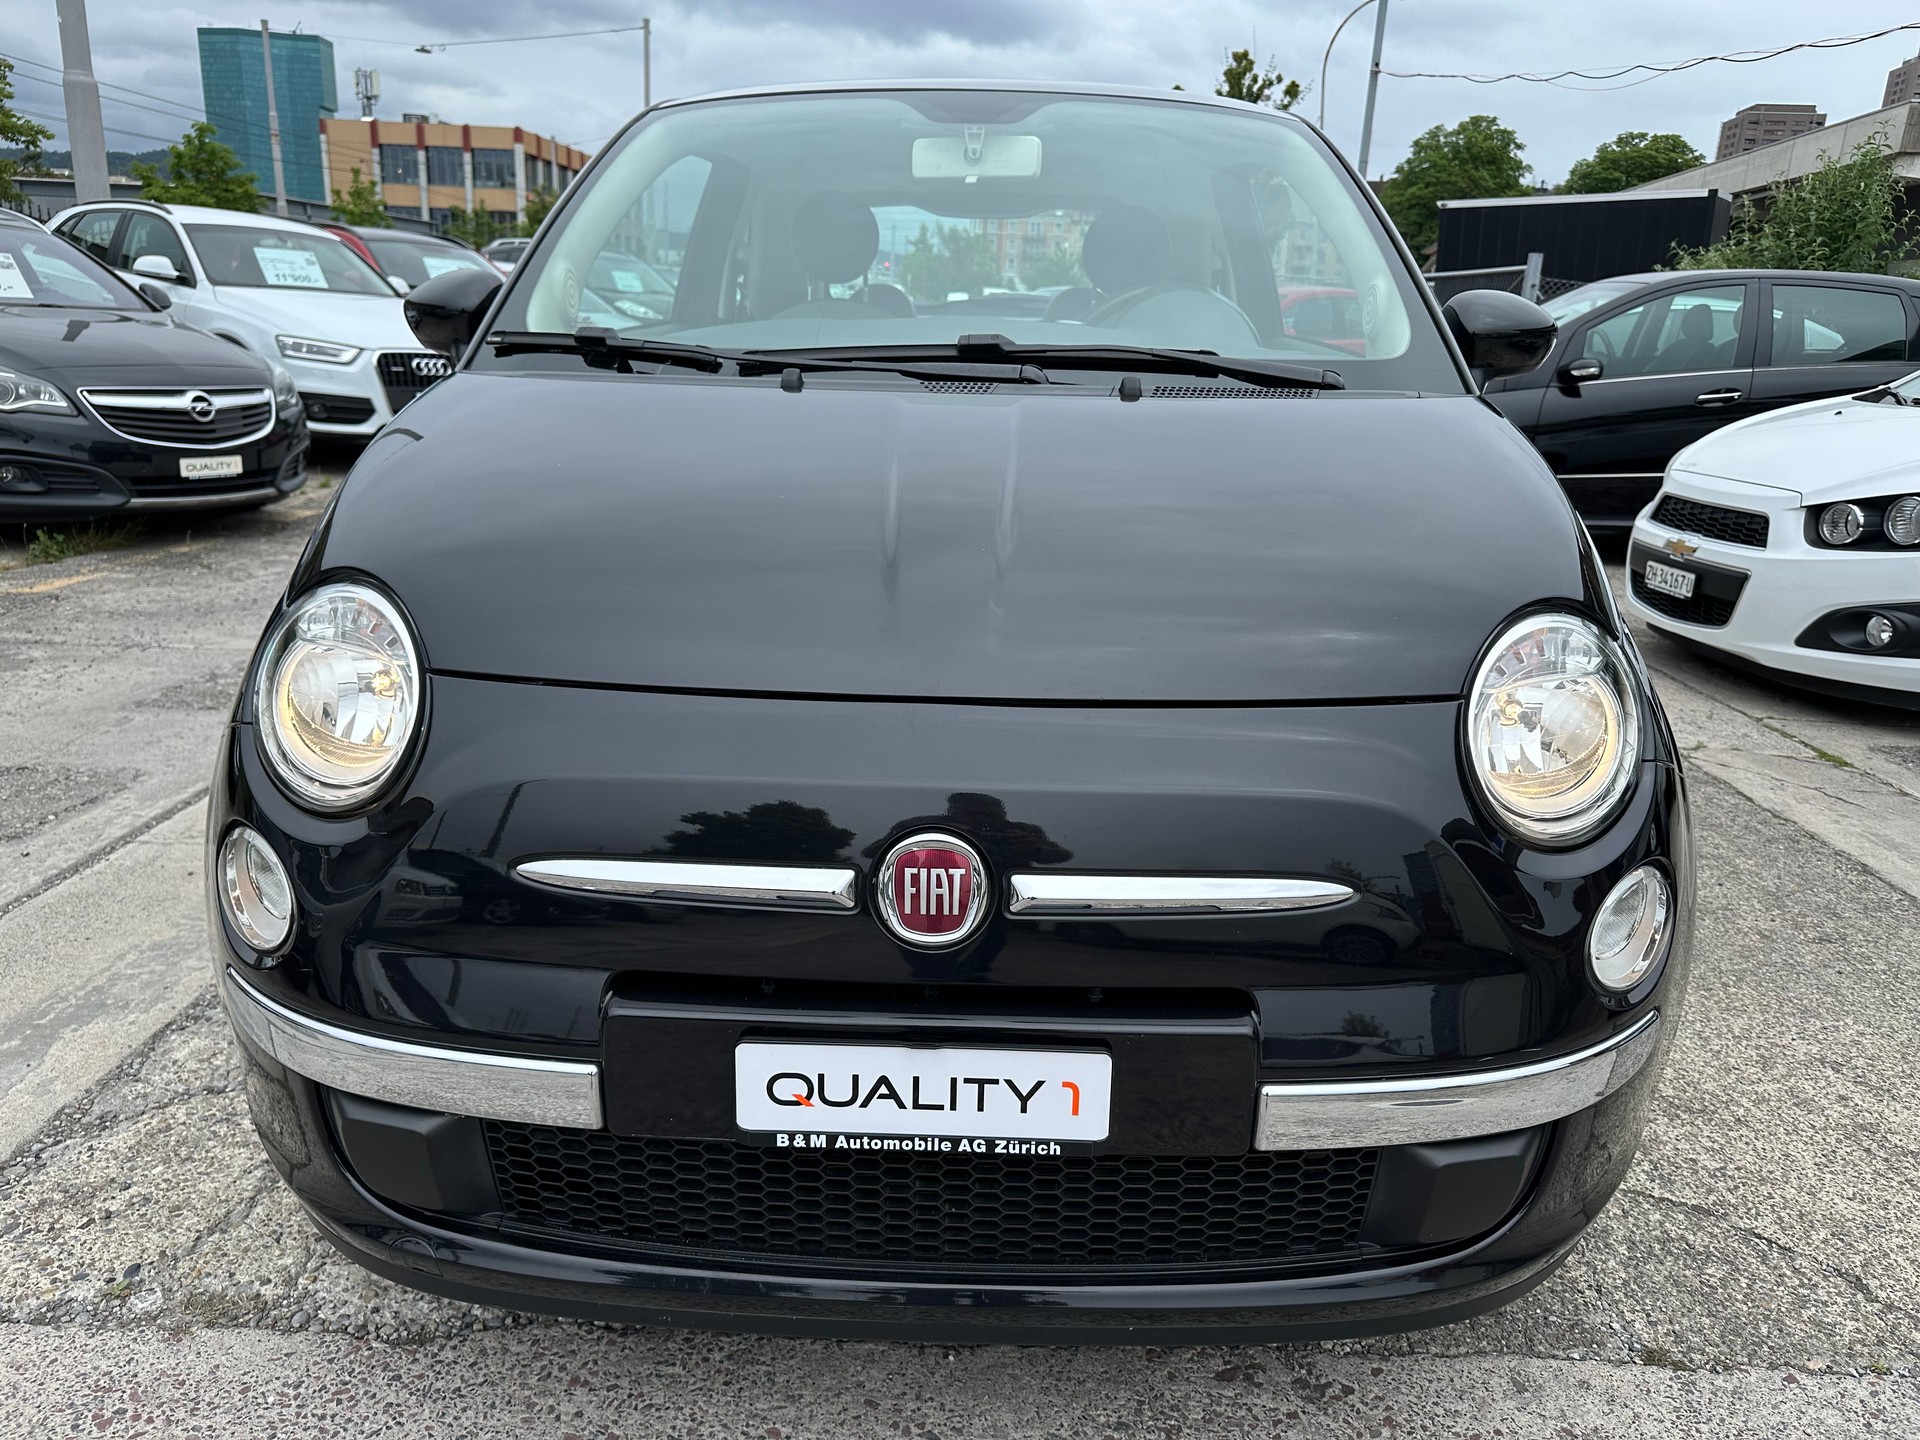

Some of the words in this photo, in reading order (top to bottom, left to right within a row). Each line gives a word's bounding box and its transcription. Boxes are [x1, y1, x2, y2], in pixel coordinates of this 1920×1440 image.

[185, 461, 232, 472] QUALITY
[904, 867, 966, 916] FIAT
[766, 1072, 1046, 1114] QUALITY
[1061, 1081, 1080, 1116] 1
[834, 1135, 952, 1152] Automobile
[957, 1138, 987, 1153] AG
[994, 1139, 1061, 1155] Zürich
